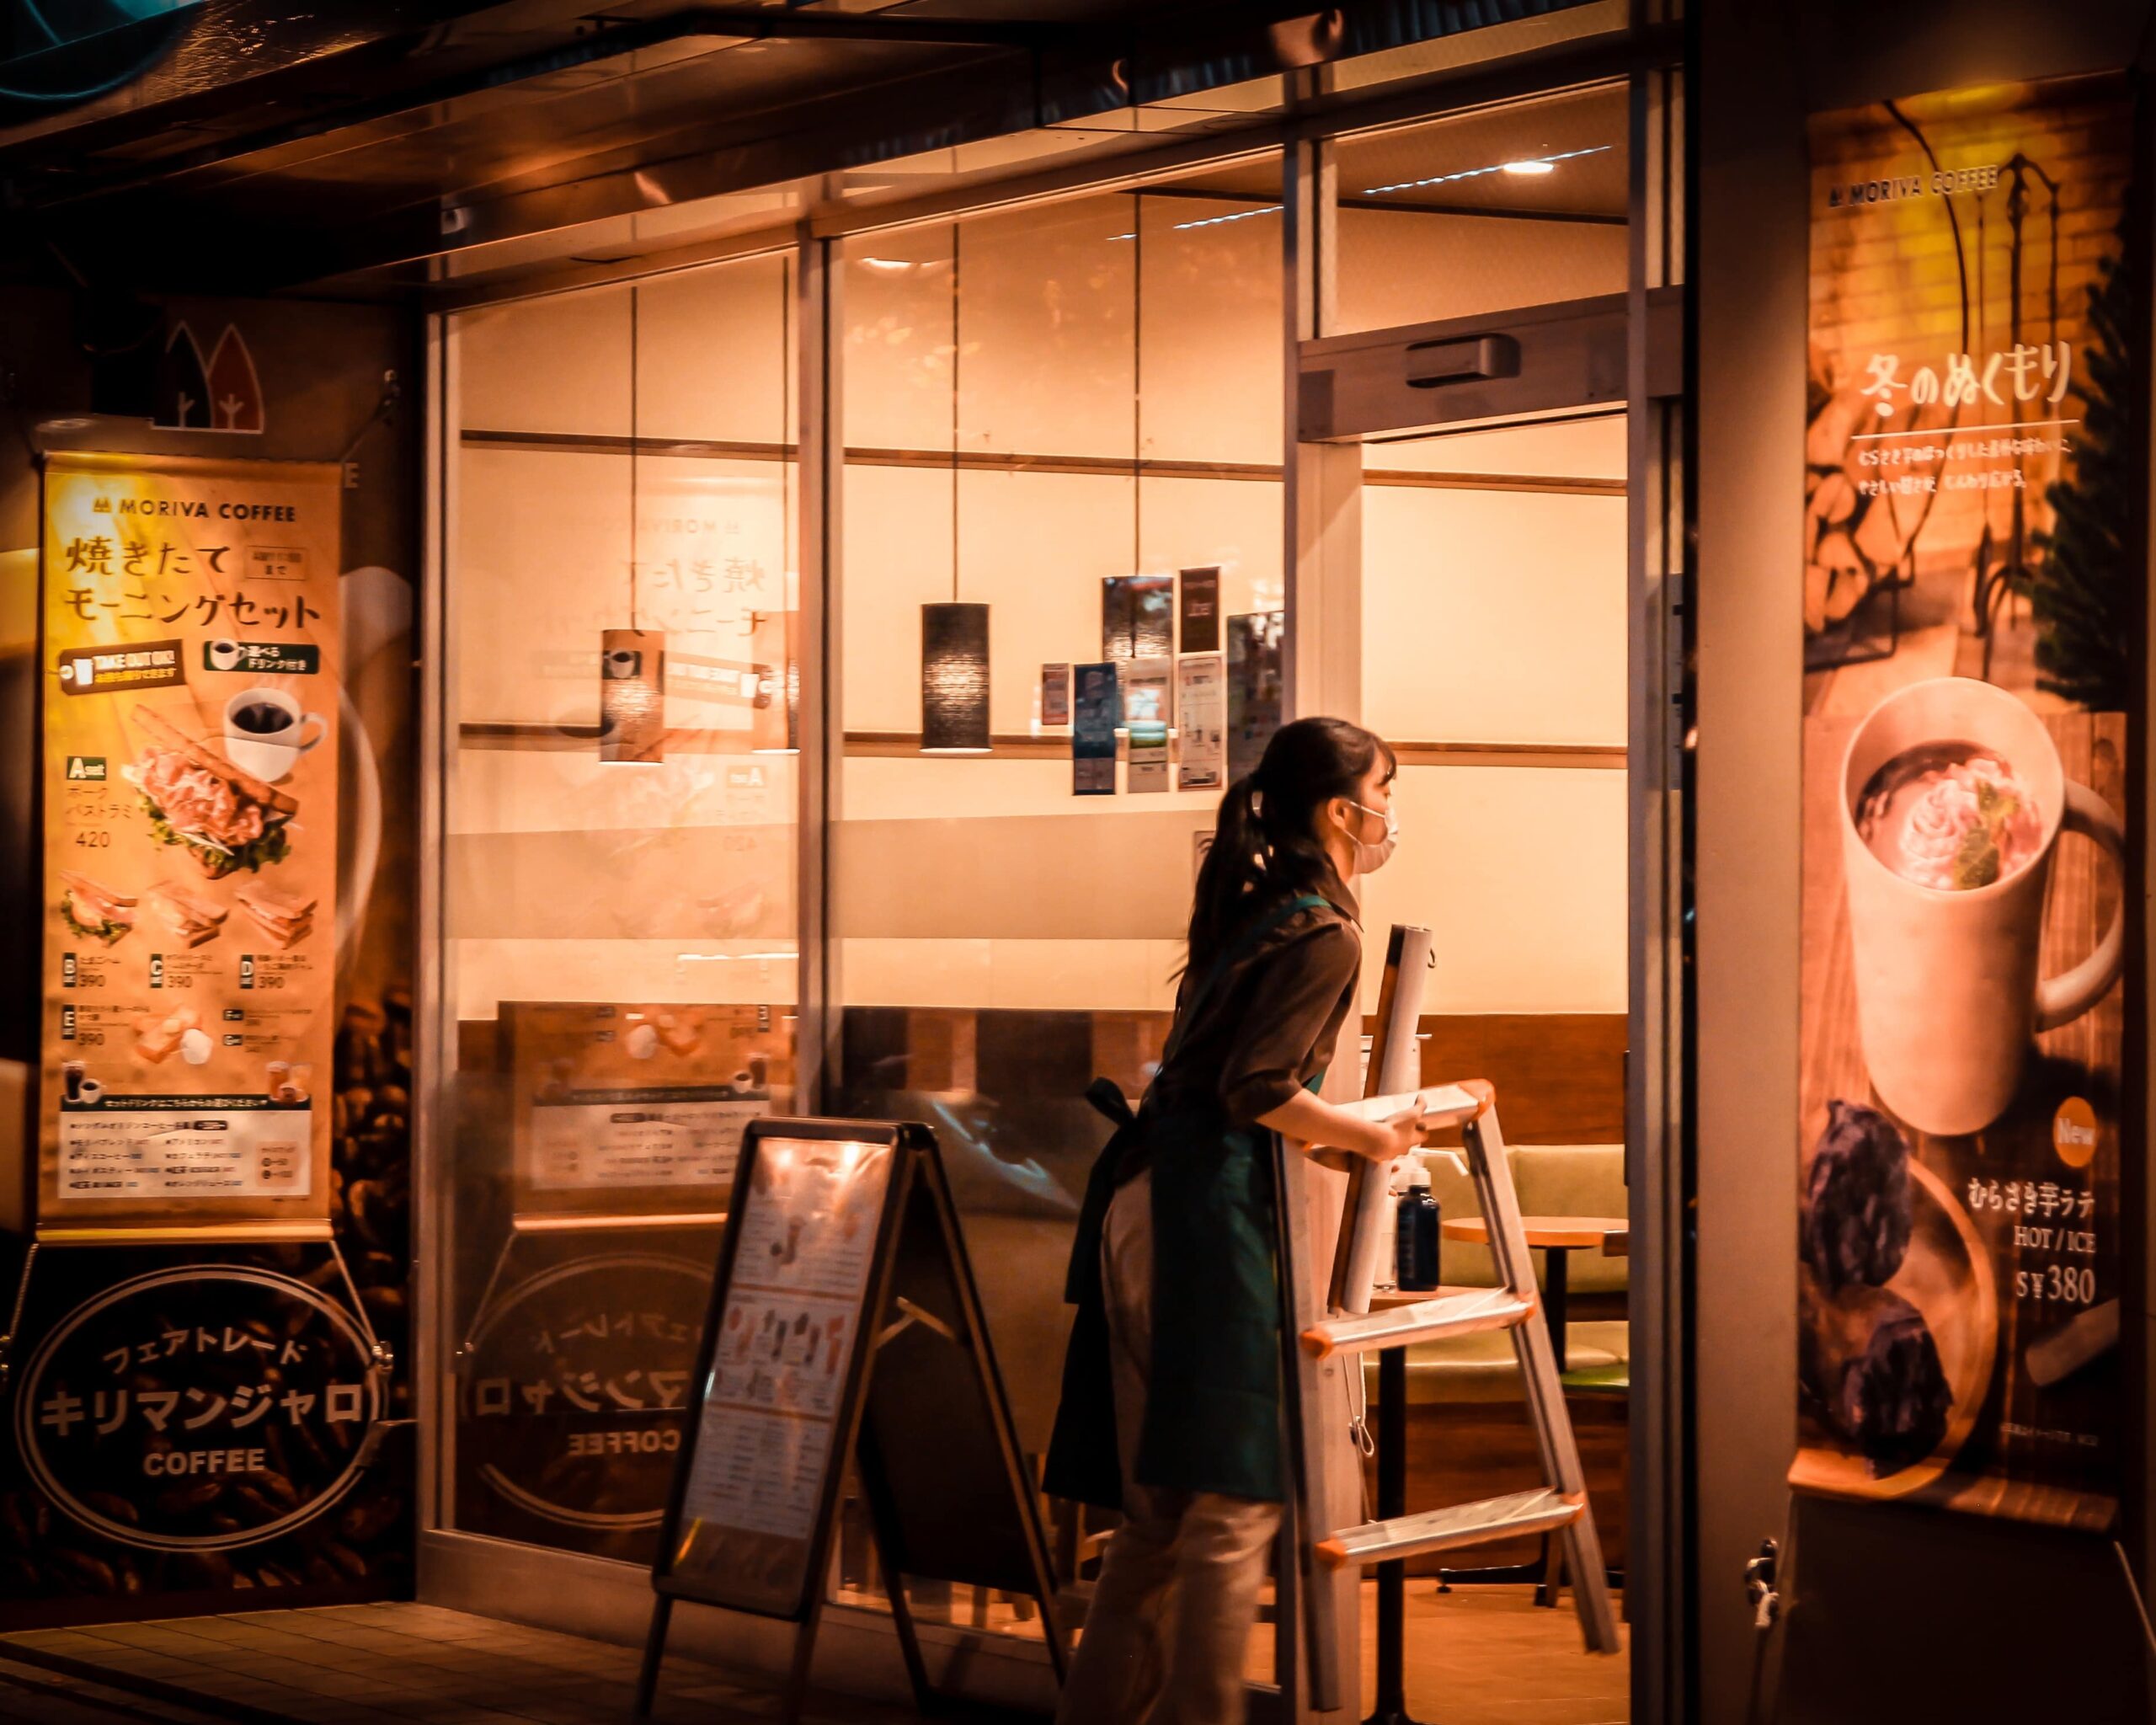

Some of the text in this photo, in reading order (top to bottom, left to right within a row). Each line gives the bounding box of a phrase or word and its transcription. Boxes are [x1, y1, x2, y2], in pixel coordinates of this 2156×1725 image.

[1929, 164, 1999, 195] COFFEE
[1860, 340, 2072, 417] 冬のぬくもり
[120, 499, 296, 523] MORIVA COFFEE
[66, 535, 231, 576] 焼きたて
[65, 587, 321, 629] モーニングセット
[68, 757, 87, 778] A
[76, 830, 110, 848] 420
[2057, 1117, 2095, 1145] New
[1968, 1177, 2095, 1219] むらさき芋ラテ
[2014, 1225, 2053, 1251] HOT
[2067, 1226, 2096, 1254] ICE
[101, 1326, 308, 1375] フェアトレード
[40, 1383, 363, 1436] キリマンジャロ
[142, 1448, 266, 1477] COFFEE
